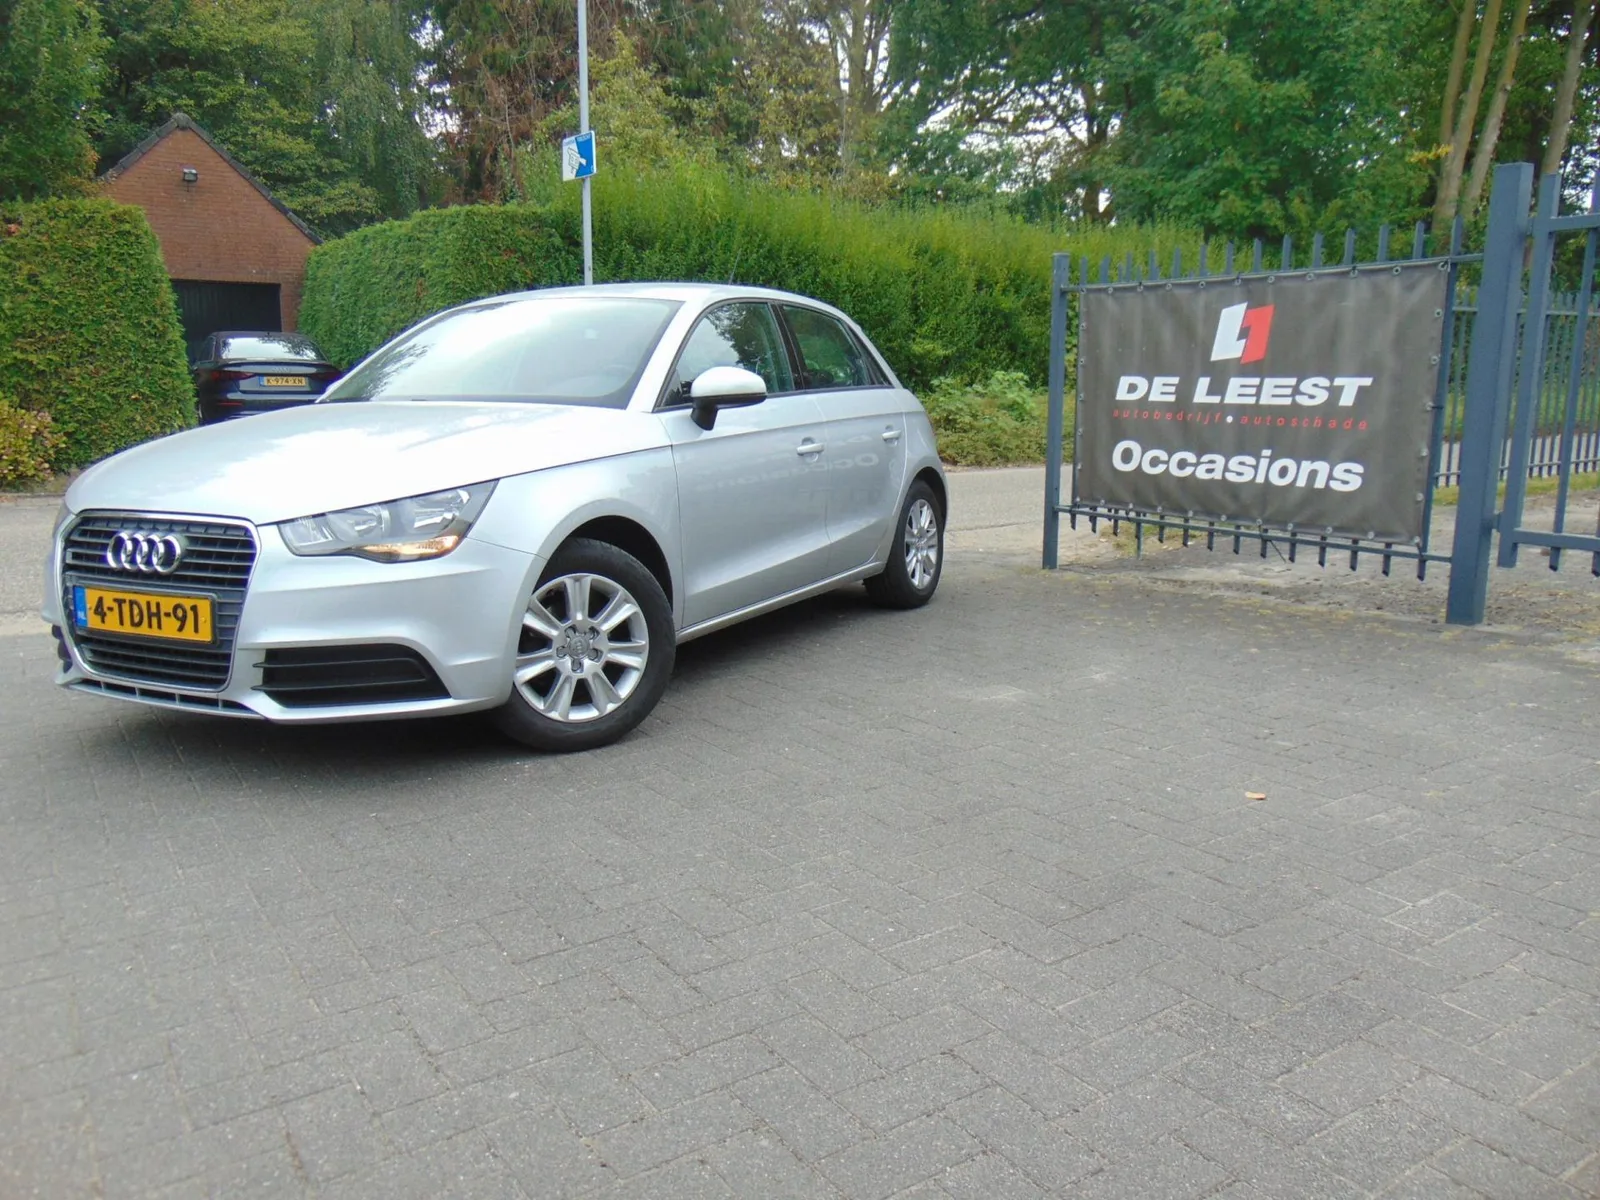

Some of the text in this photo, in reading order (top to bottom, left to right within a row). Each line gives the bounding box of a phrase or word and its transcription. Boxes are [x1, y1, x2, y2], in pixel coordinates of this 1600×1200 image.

[1115, 376, 1374, 406] DE LEEST
[1113, 409, 1369, 431] autobedrijf autoschade
[1112, 440, 1365, 492] Occasions
[93, 596, 200, 634] 4-TDH-91
